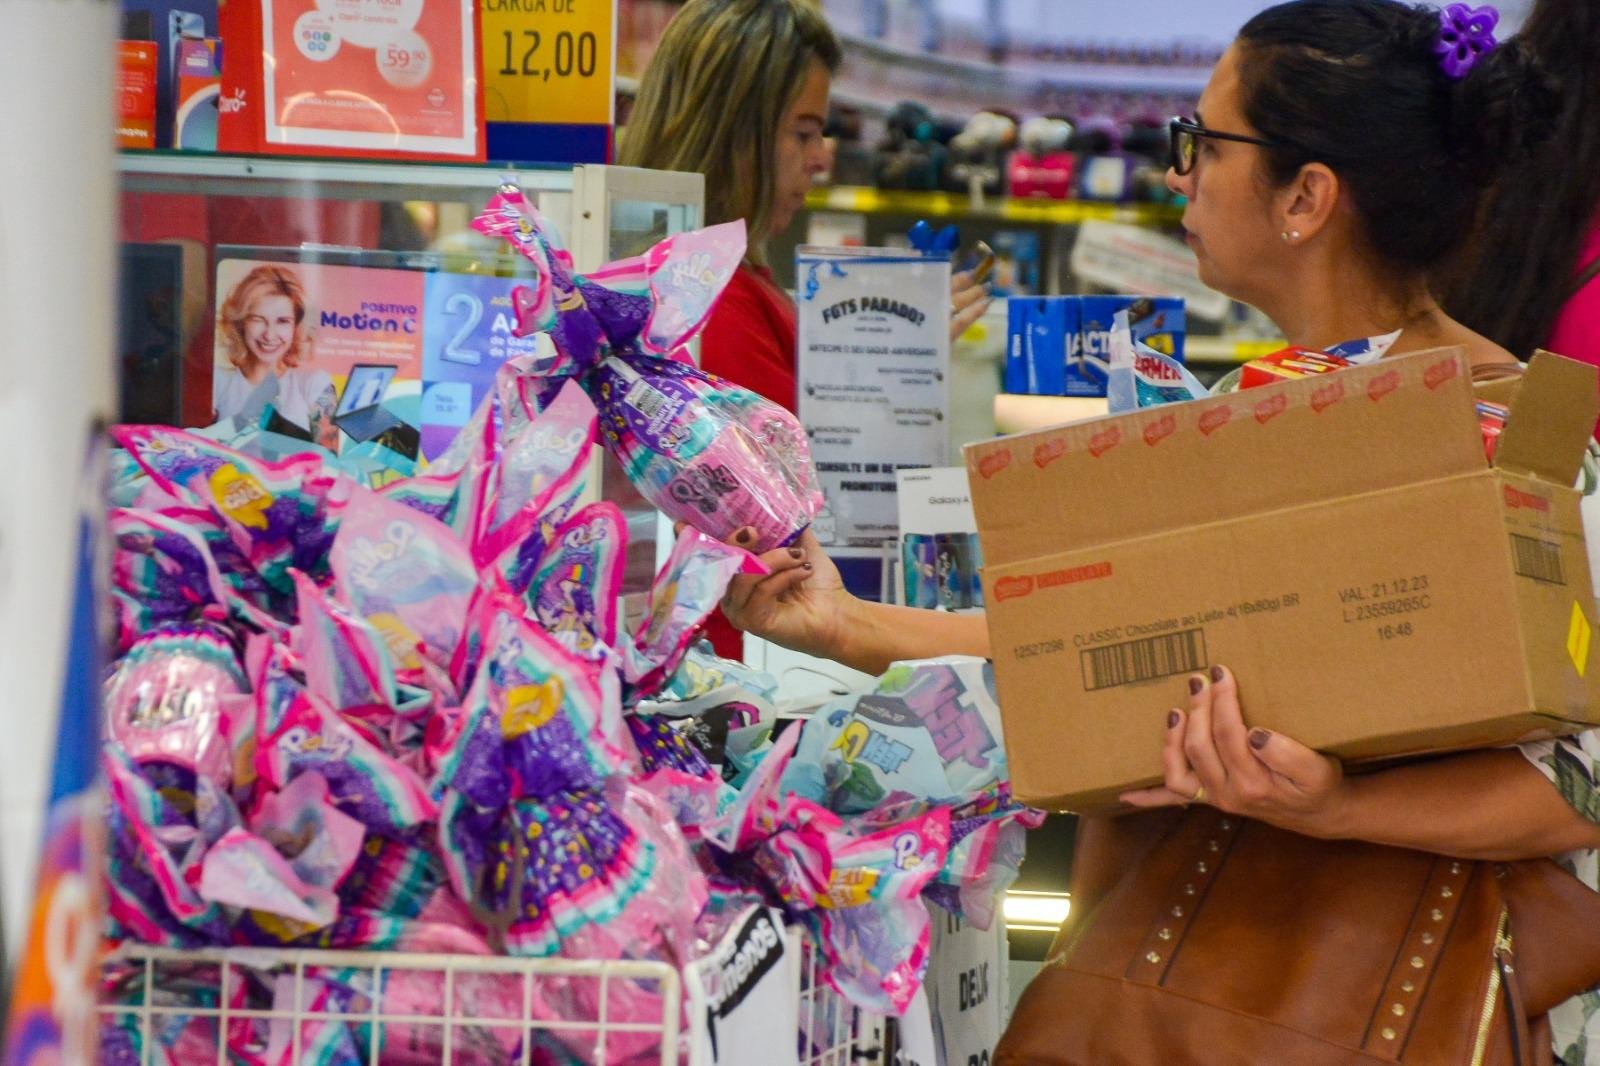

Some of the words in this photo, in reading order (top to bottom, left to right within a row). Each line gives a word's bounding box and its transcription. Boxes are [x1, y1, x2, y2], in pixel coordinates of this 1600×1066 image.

[499, 30, 597, 82] 12,00
[361, 302, 417, 316] POSITIVO
[821, 298, 857, 325] FGTS
[860, 297, 926, 328] PARADO?
[320, 311, 398, 332] Motion
[440, 292, 483, 365] 2
[815, 461, 862, 473] CONSULTE
[839, 480, 897, 492] PROMOTORE
[928, 496, 961, 506] Galaxy
[1072, 626, 1123, 649] CLASSIC
[1125, 617, 1179, 638] Chocolate
[1181, 615, 1196, 627] ao
[1197, 609, 1225, 625] Leite
[1281, 592, 1302, 609] BR
